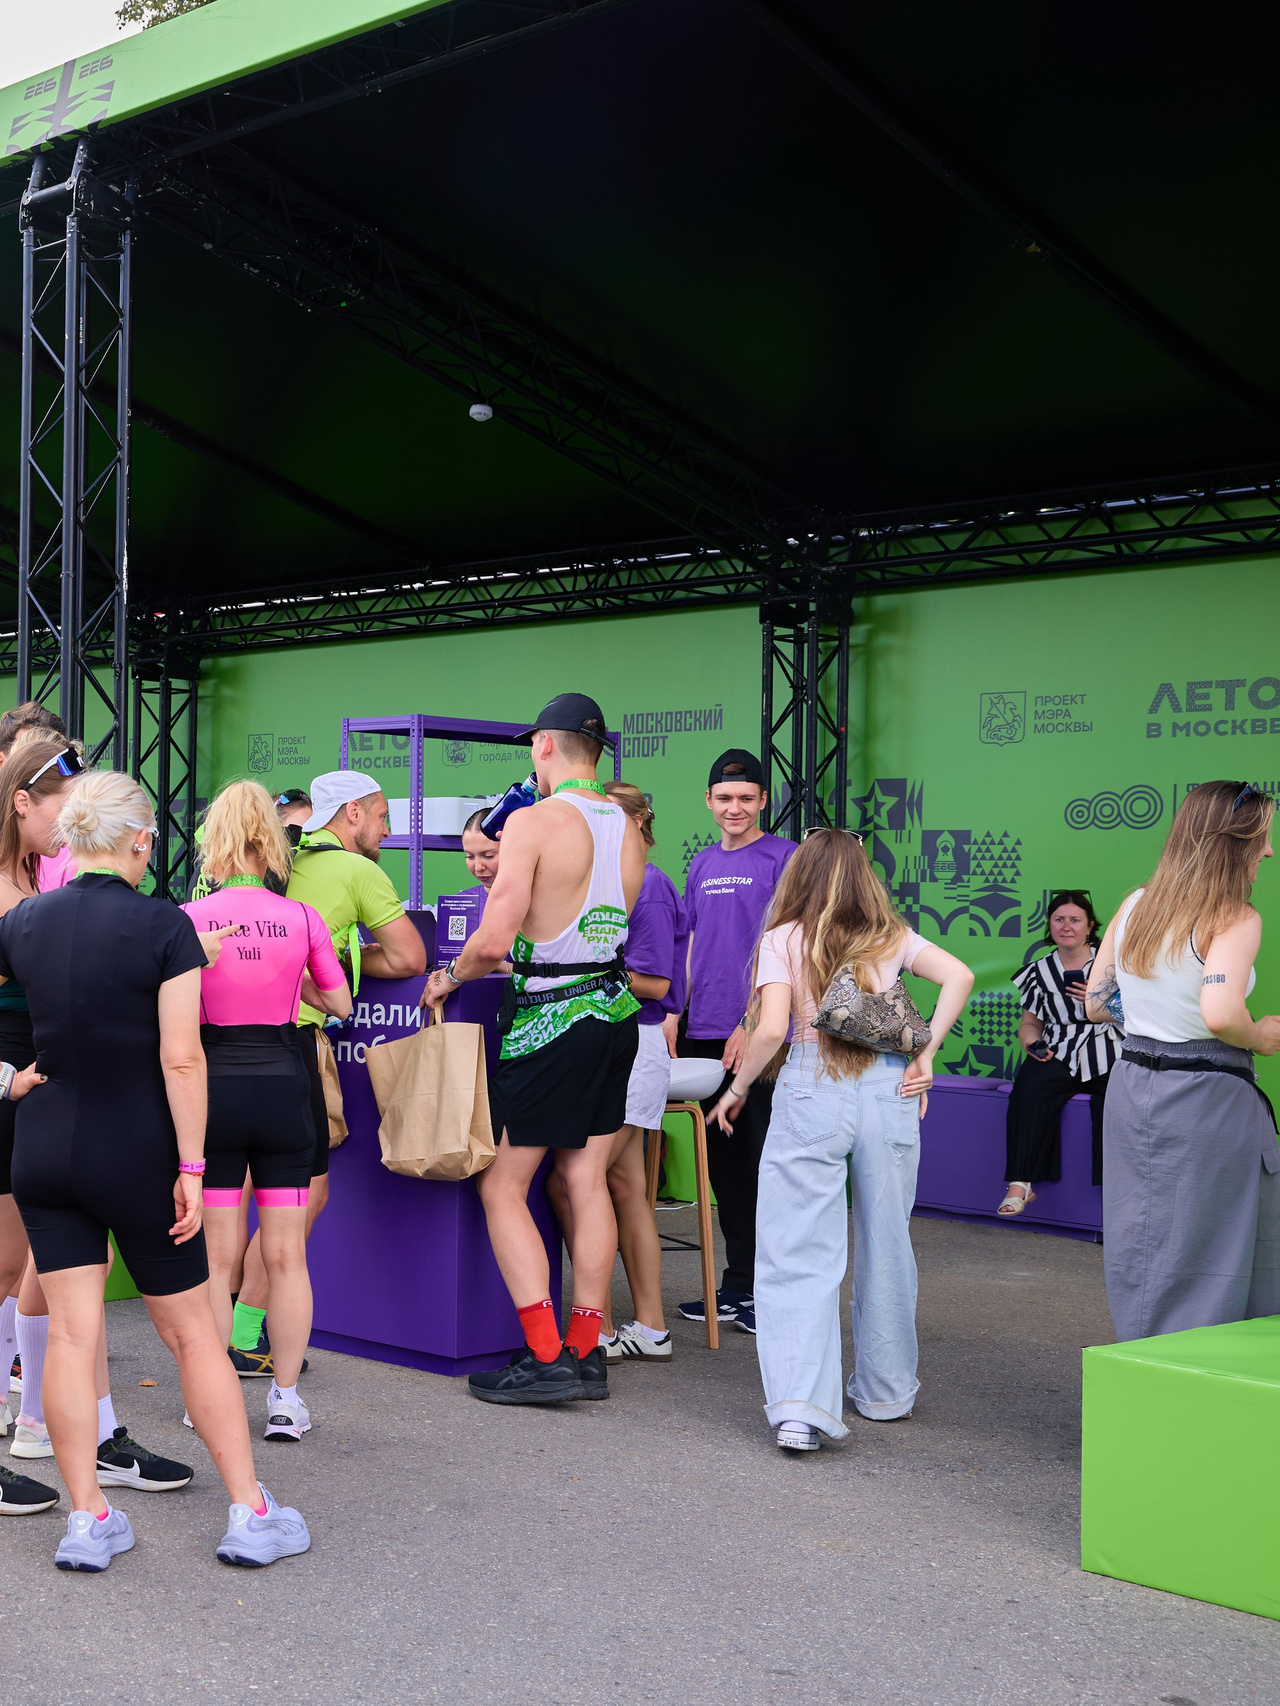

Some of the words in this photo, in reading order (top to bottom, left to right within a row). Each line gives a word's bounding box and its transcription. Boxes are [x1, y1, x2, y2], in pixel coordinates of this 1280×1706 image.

[1035, 694, 1087, 706] ПРОЕКТ
[1147, 677, 1280, 714] ЛЕТО
[623, 703, 724, 735] МОСКОВСКИЙ
[1034, 708, 1071, 720] МЭРА
[1034, 722, 1093, 734] МОСКВЫ
[1146, 723, 1162, 738] В
[1171, 718, 1280, 737] МОСКВЕ
[277, 736, 307, 746] ПРОЕКТ
[622, 735, 669, 759] СПОРТ
[277, 746, 299, 756] МЭРА
[277, 756, 311, 766] МОСКВЫ
[351, 755, 411, 769] МОСКВЕ
[479, 752, 512, 764] города
[731, 876, 754, 886] STAR
[255, 920, 288, 938] Vita
[237, 946, 261, 960] Yuli
[564, 980, 597, 997] UNDER
